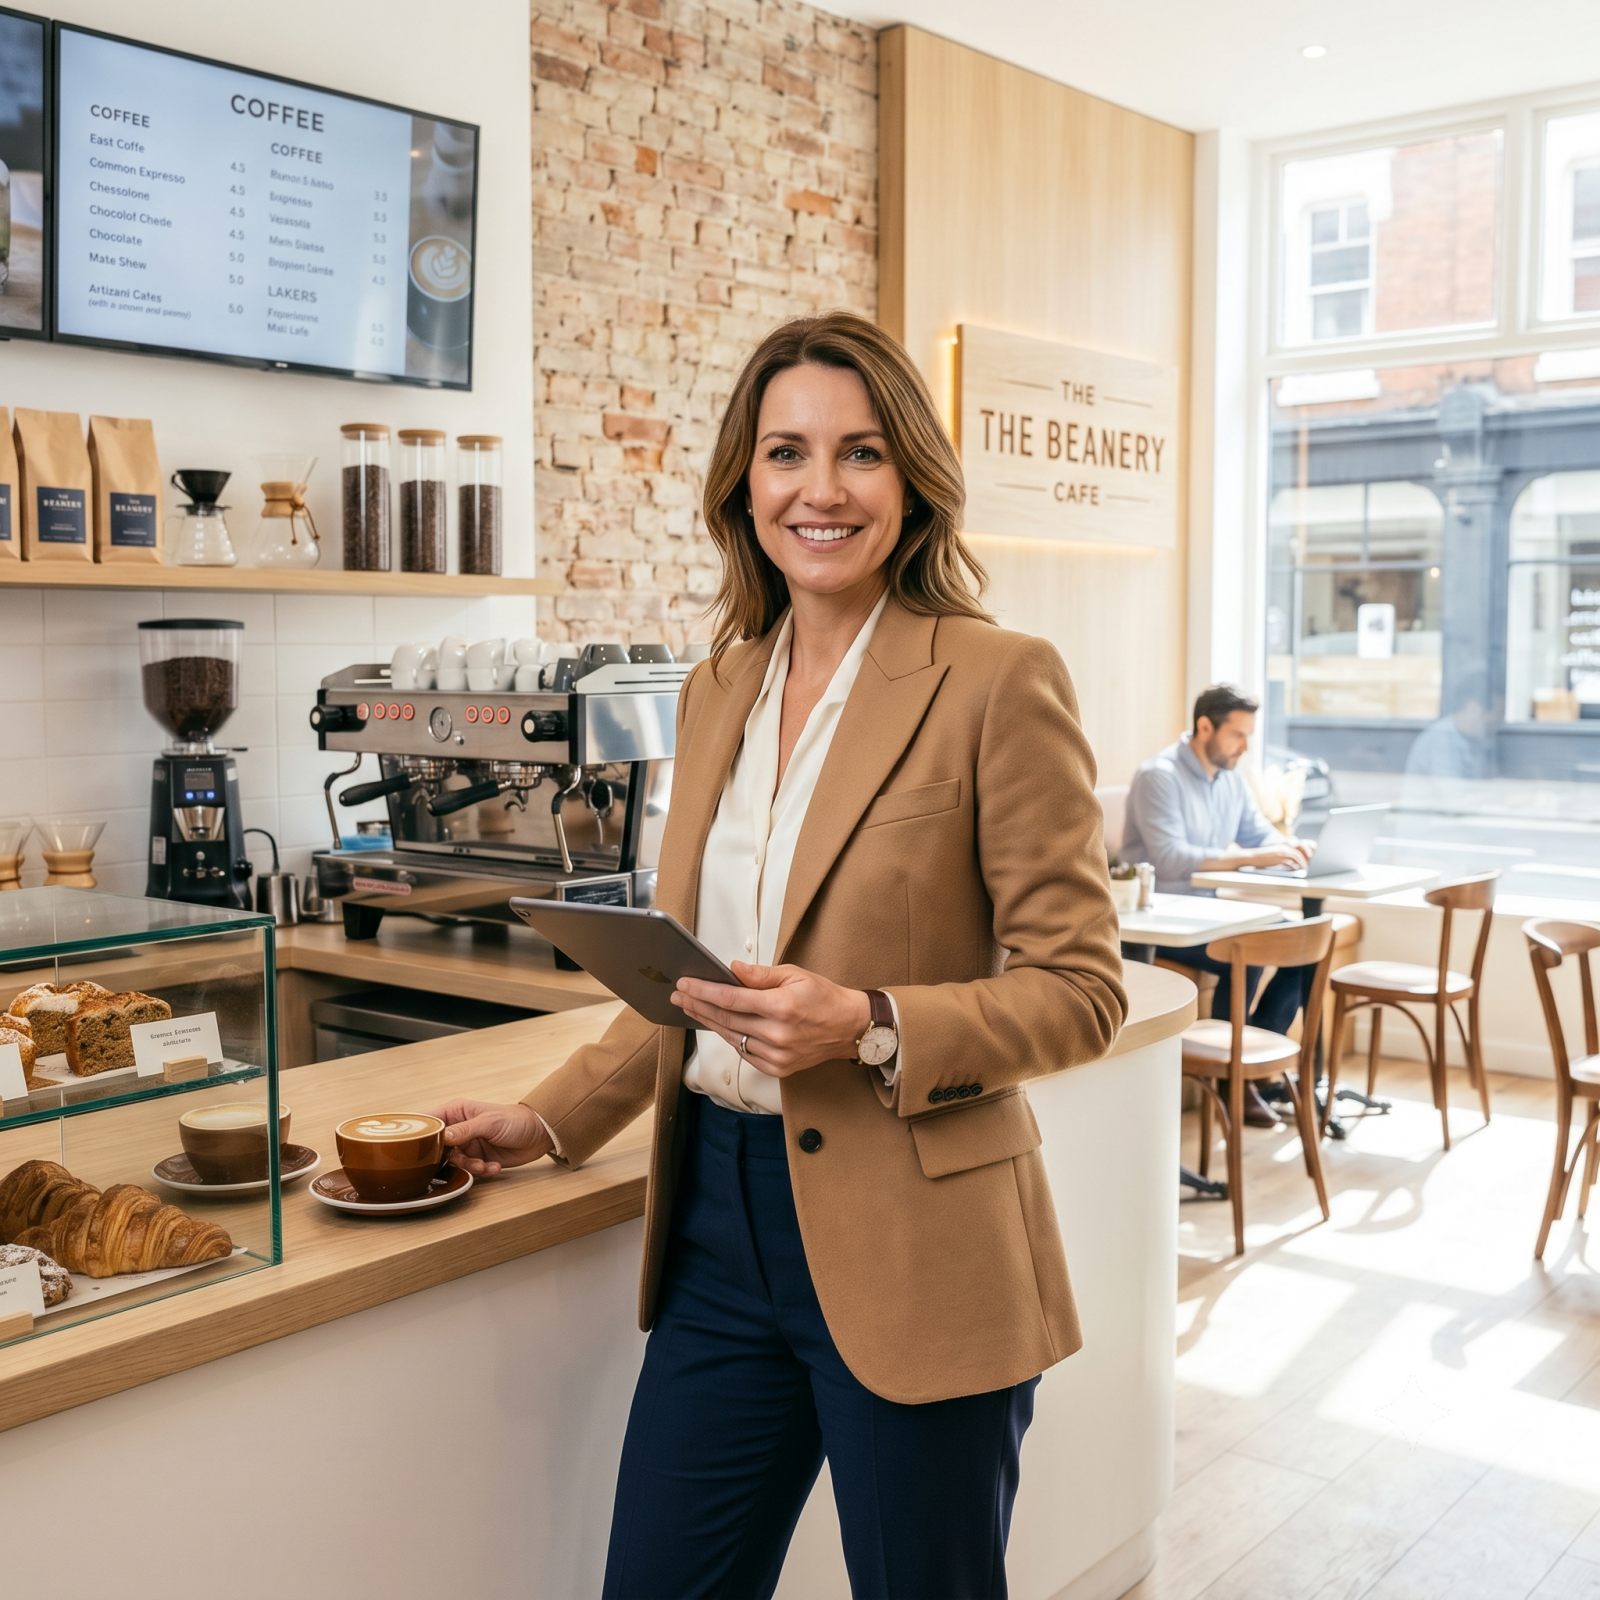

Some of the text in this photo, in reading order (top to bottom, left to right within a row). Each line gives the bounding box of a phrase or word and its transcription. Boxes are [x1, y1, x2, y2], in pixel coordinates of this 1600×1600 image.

[90, 104, 150, 128] COFFEE
[231, 94, 325, 133] COFFEE
[90, 133, 145, 153] East Coffe
[270, 142, 323, 164] COFFEE
[89, 157, 186, 184] Common Expresso
[230, 162, 246, 173] 4.5
[89, 181, 150, 201] Chessolone
[229, 185, 245, 196] 4.5
[139, 213, 172, 228] Chede
[229, 207, 245, 218] 4.5
[89, 228, 143, 246] Chocolate
[229, 229, 245, 241] 4.5
[89, 252, 147, 270] Mate Shew
[229, 252, 244, 263] 5.0
[229, 274, 244, 285] 5.0
[88, 284, 130, 298] Artizani
[267, 285, 317, 303] LAKERS
[228, 303, 244, 315] 5.0
[1061, 380, 1095, 406] THE
[980, 409, 1165, 473] THE BEANERY
[1053, 482, 1099, 506] CAFE
